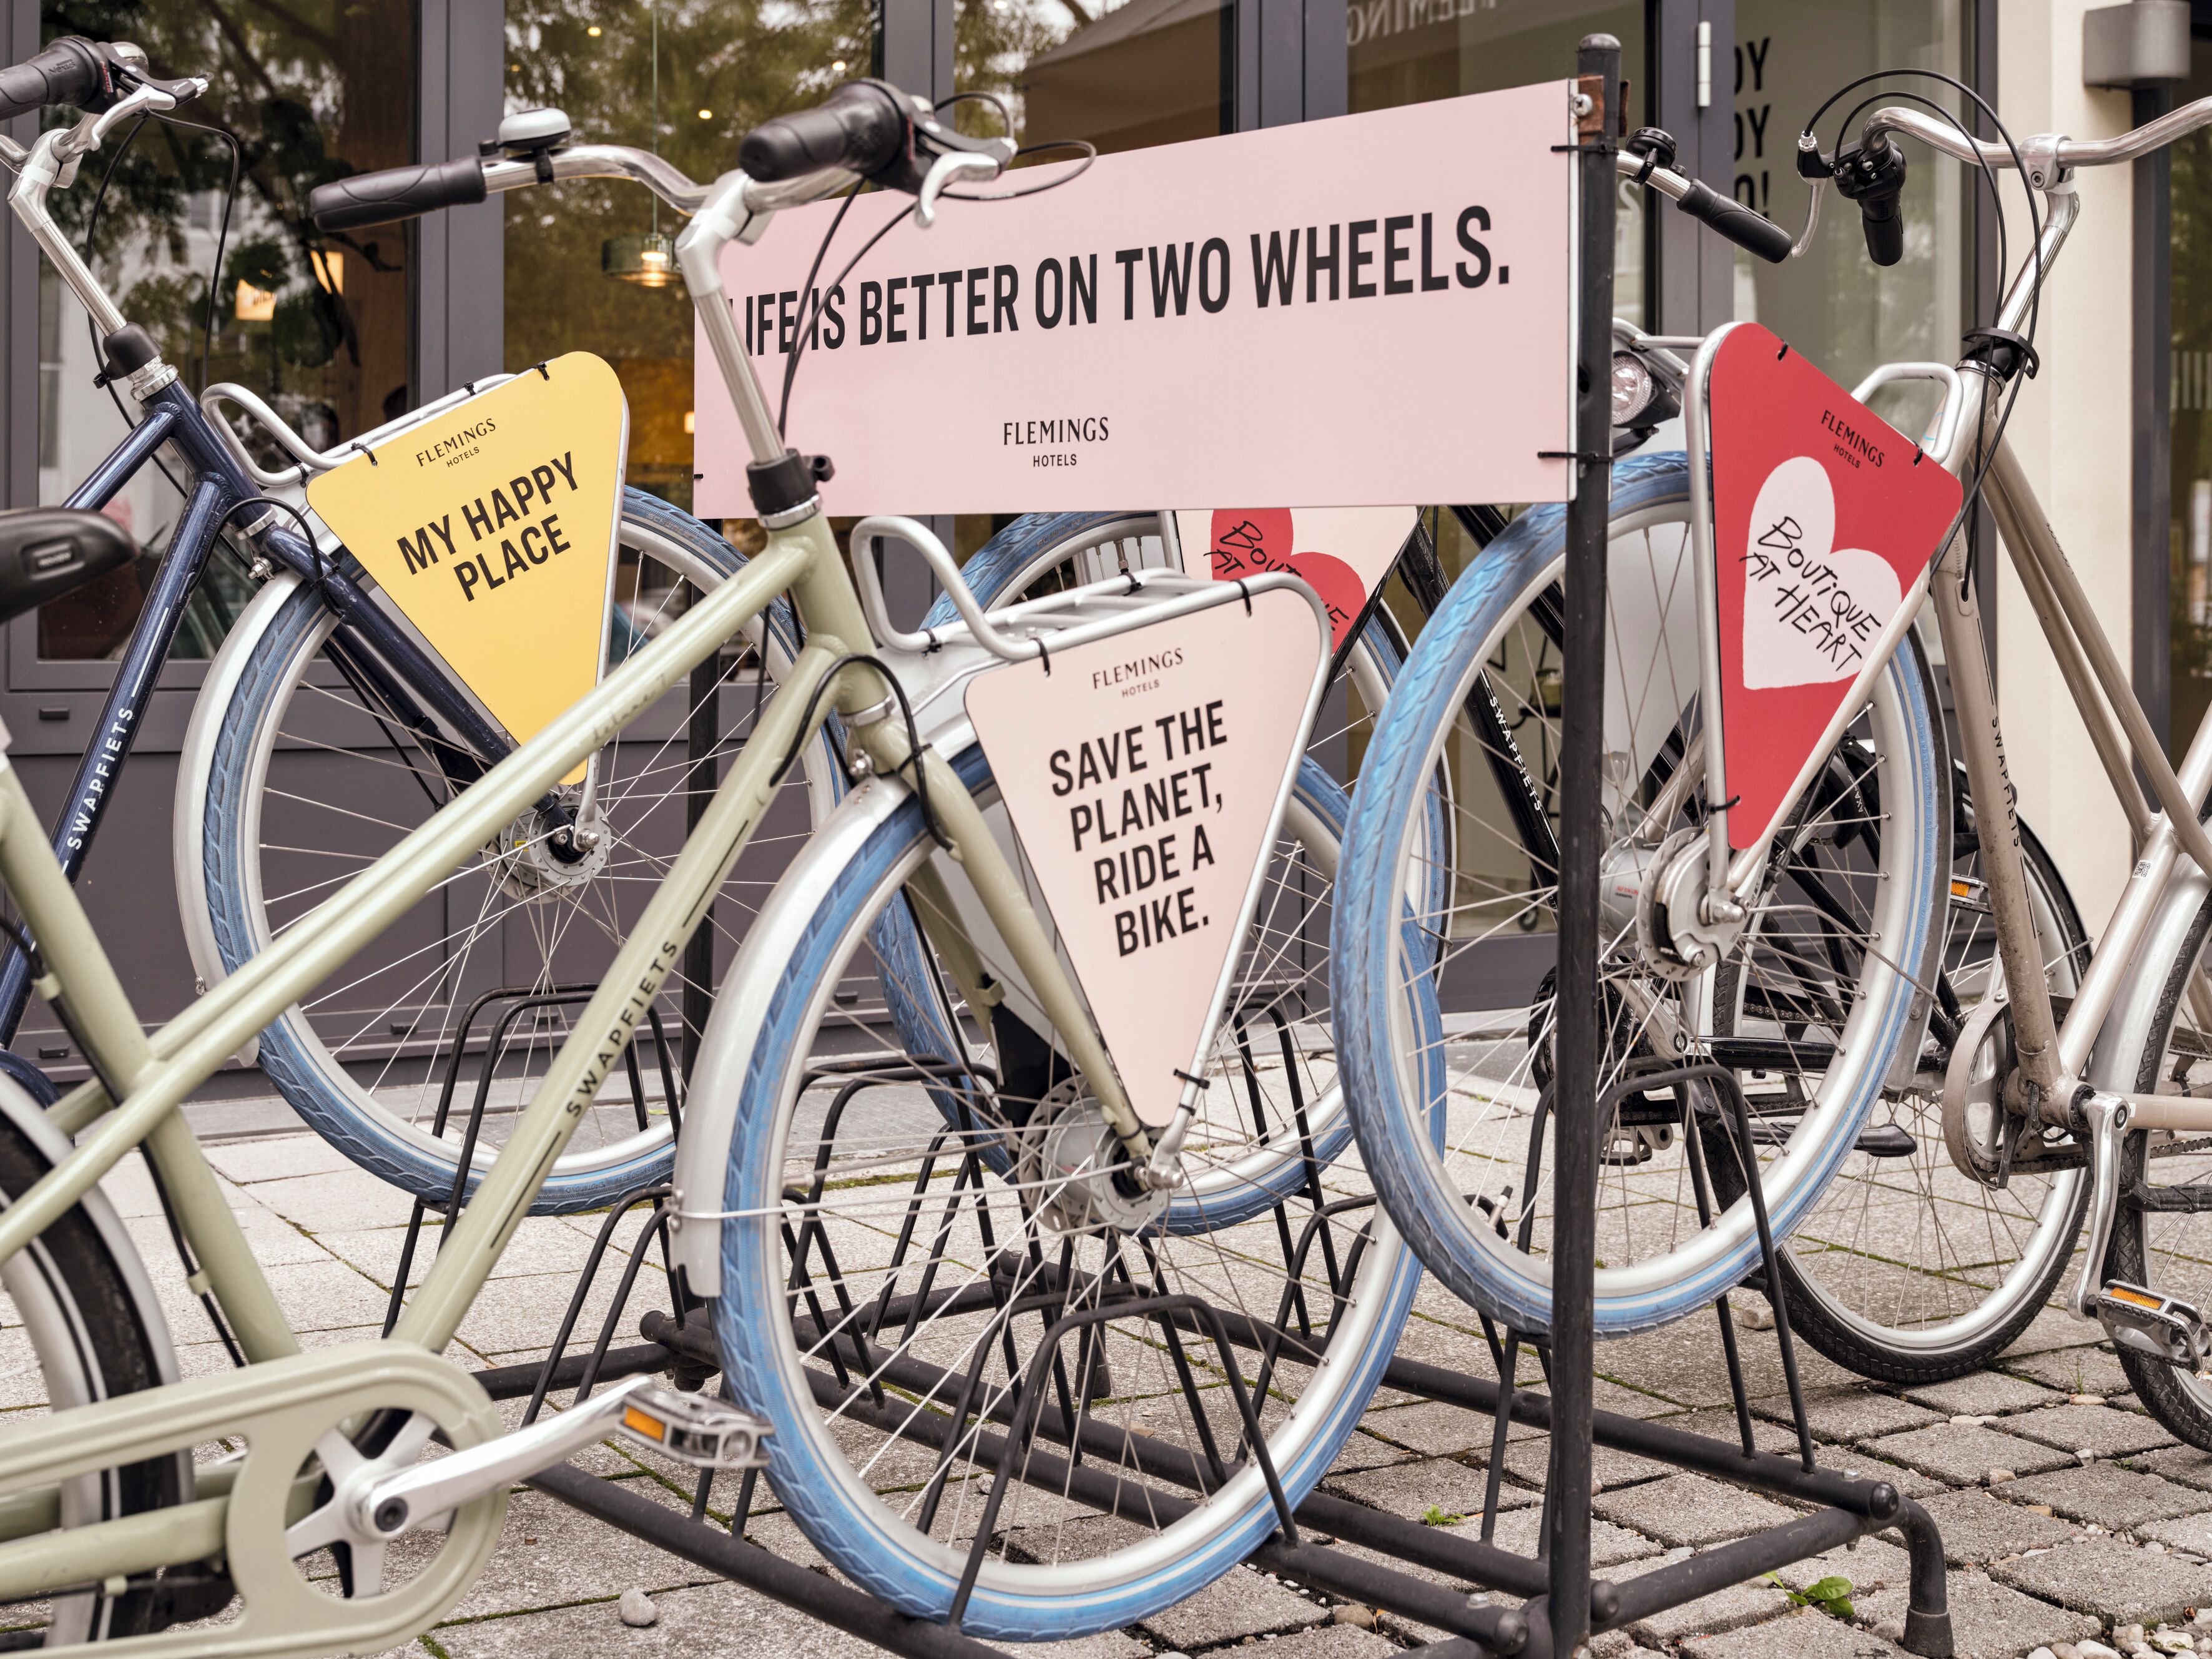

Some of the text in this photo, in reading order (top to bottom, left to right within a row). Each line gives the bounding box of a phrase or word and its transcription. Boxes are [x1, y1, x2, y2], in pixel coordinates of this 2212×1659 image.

[728, 205, 1510, 356] IFE IS BETTER ON TWO WHEELS.
[416, 418, 496, 467] FLEMINGS
[446, 446, 479, 468] HOTELS
[1003, 416, 1109, 445] FLEMINGS
[1033, 453, 1077, 468] HOTELS
[1821, 410, 1885, 468] FLEMINGS
[1833, 443, 1861, 468] HOTELS
[396, 451, 578, 576] MY HAPPY
[453, 513, 571, 602] PLACE
[1203, 548, 1245, 574] AT
[1739, 551, 1862, 672] AT HEART
[1093, 647, 1183, 689] FLEMINGS
[1122, 679, 1159, 697] HOTELS
[67, 707, 134, 850] SWAPFIETS
[1049, 699, 1227, 797] SAVE THE
[1490, 696, 1542, 812] SWAPFIETS
[1070, 762, 1224, 852] PLANET,
[1855, 790, 1863, 812] AXA
[1094, 824, 1215, 905] RIDE A
[1114, 887, 1209, 958] BIKE.
[566, 940, 677, 1118] SWAPFIETS
